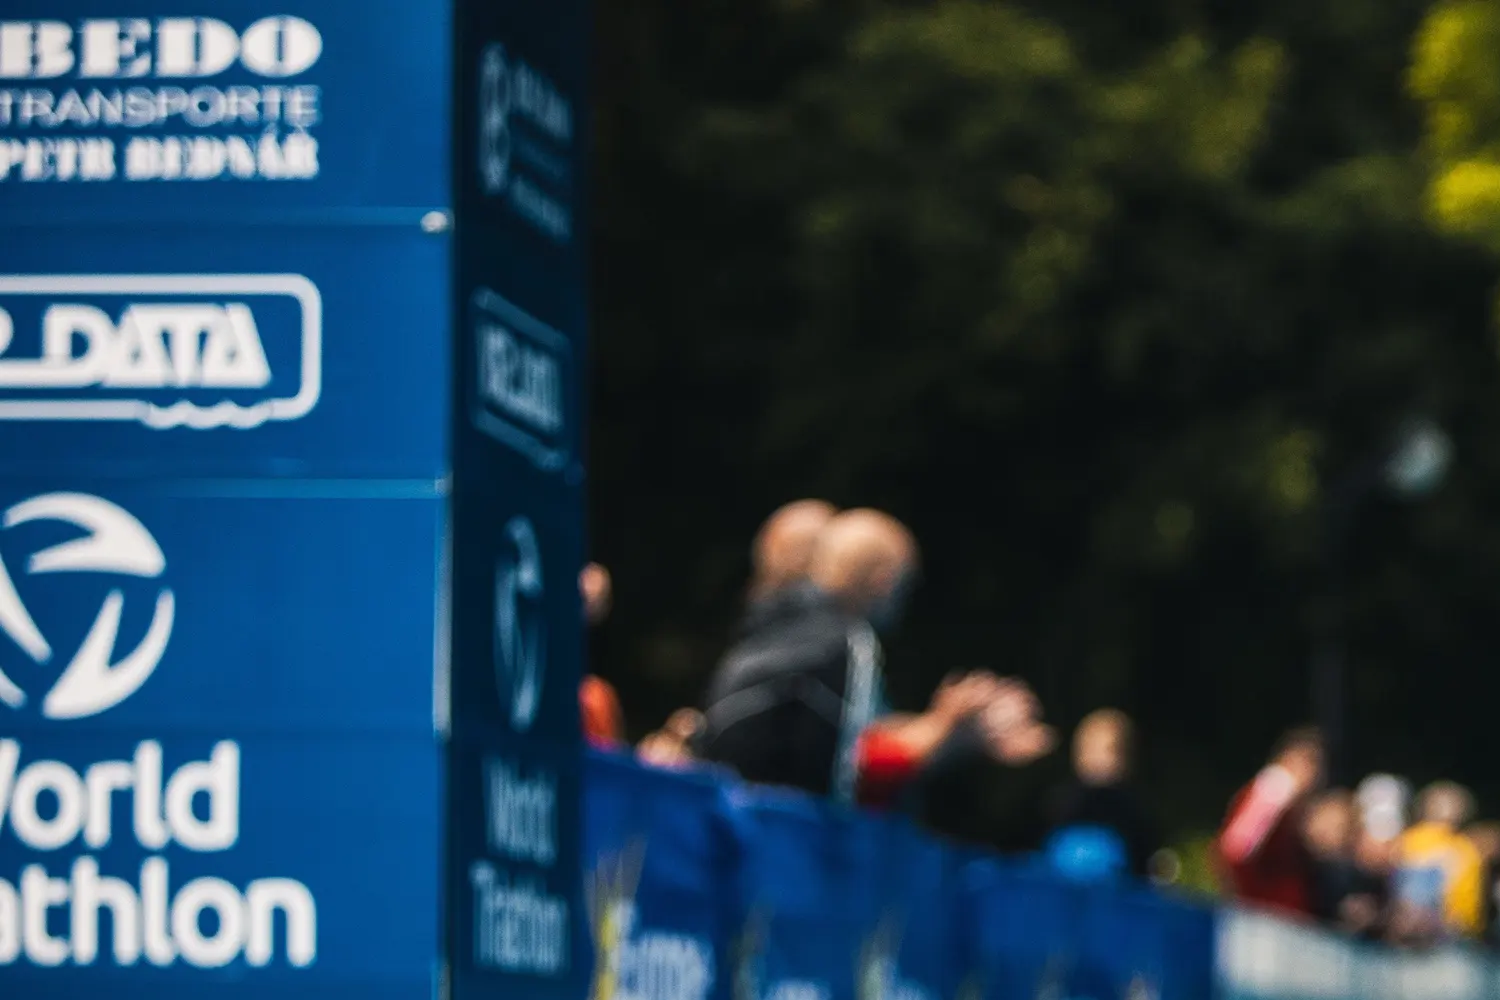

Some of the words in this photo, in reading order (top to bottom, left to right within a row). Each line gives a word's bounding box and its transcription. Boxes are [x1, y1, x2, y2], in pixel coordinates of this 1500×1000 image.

[0, 14, 323, 79] BEDO
[0, 738, 241, 852] orld
[0, 855, 317, 968] thlon
